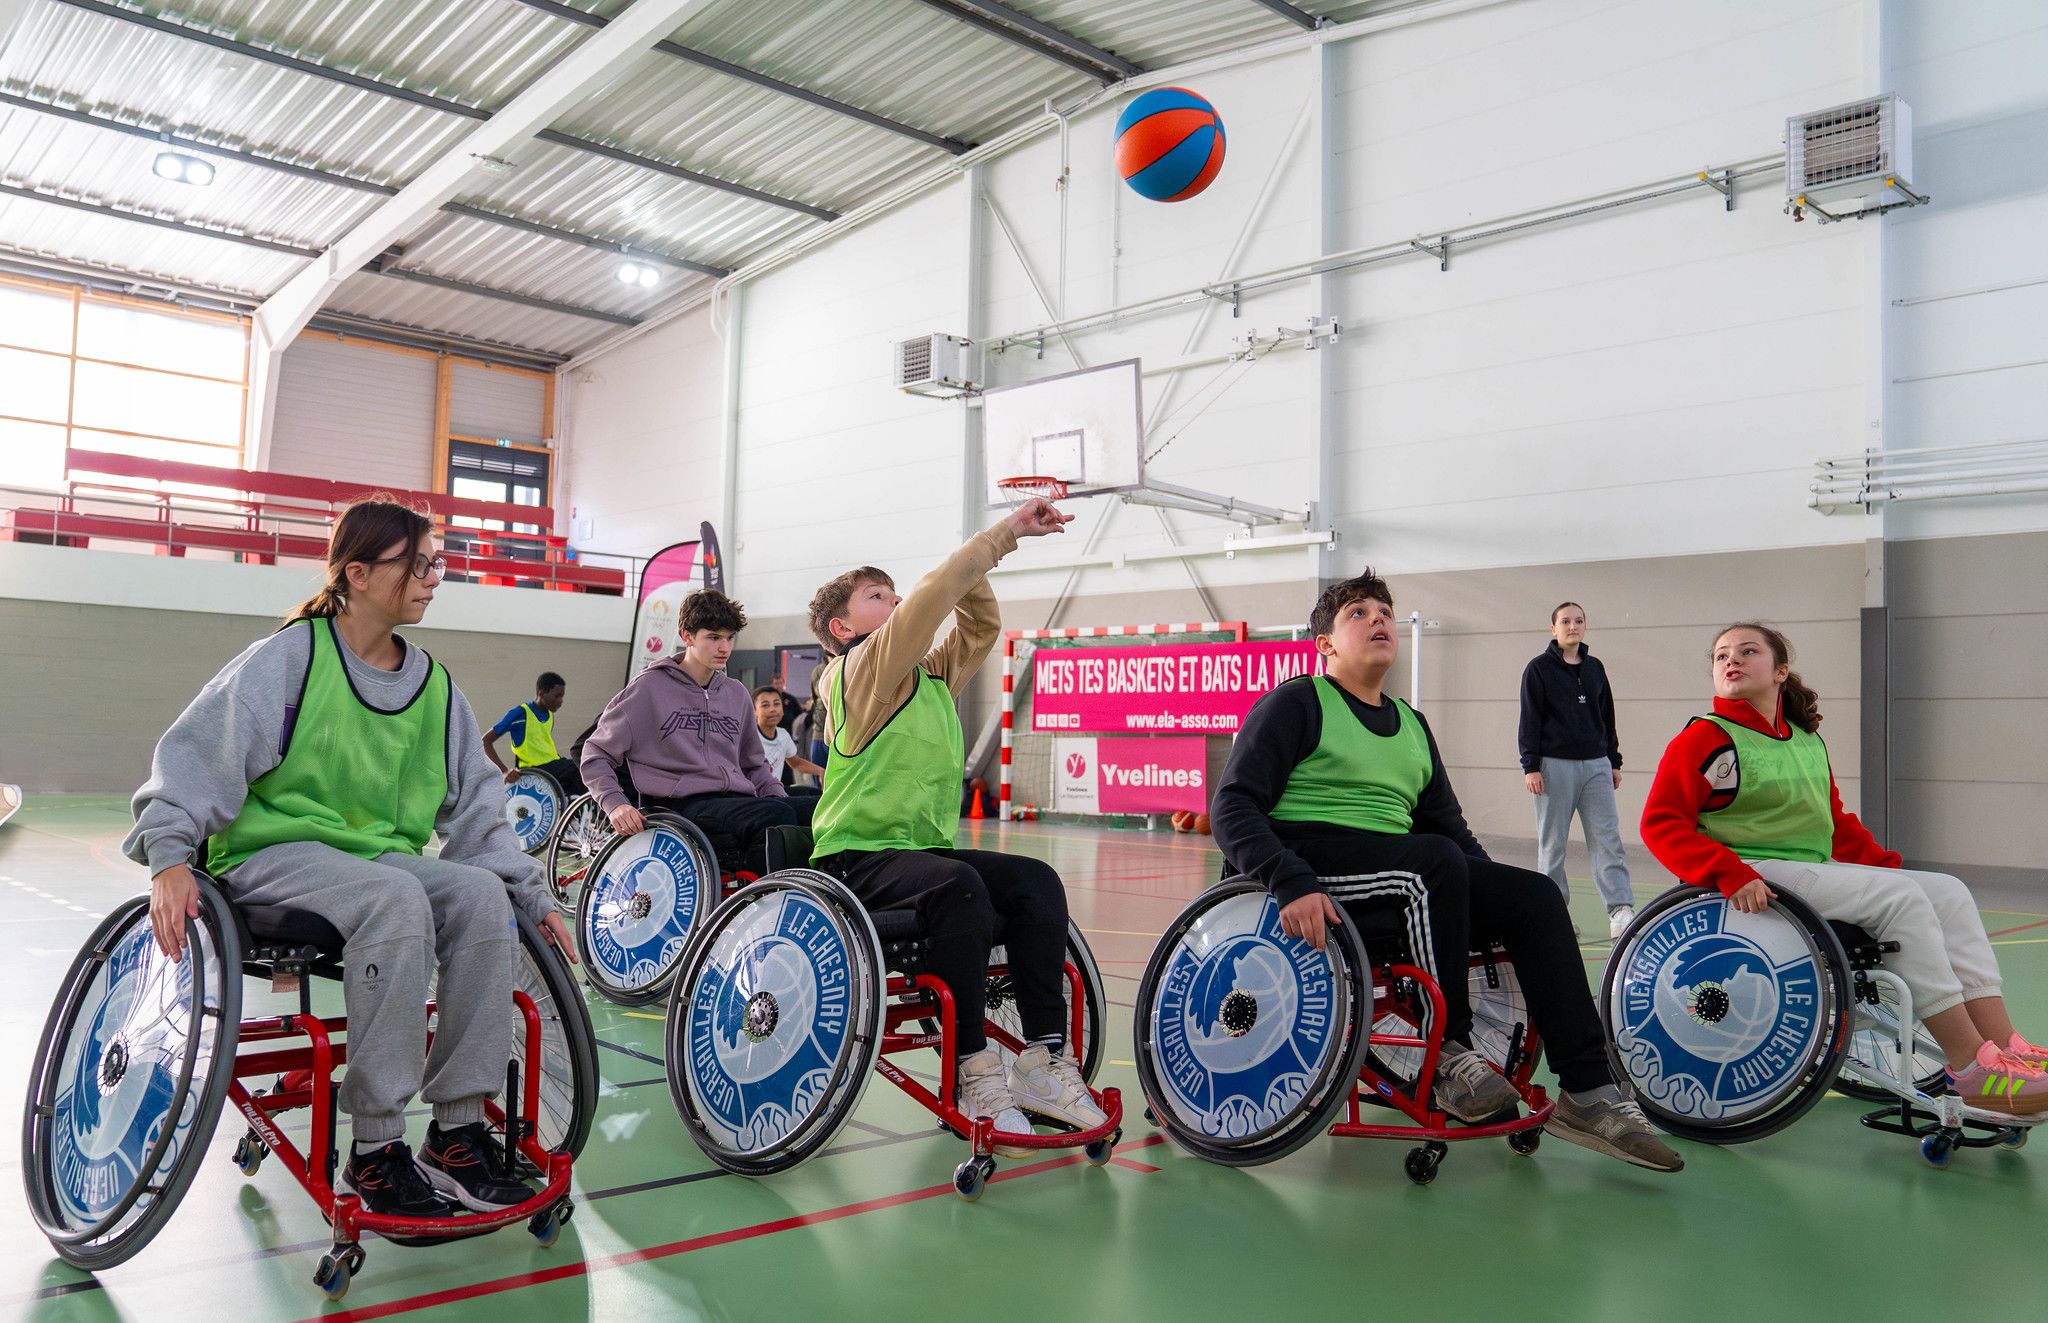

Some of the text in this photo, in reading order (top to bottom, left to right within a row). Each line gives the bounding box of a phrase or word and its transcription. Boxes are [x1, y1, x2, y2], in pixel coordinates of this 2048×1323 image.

[1036, 652, 1328, 694] METS TES BASKETS ET BATS LA MALA
[1126, 711, 1238, 729] www.ela-asso.com
[1101, 763, 1203, 787] Yvelines
[656, 837, 696, 917] LE CHESNAY
[787, 906, 846, 1036] LE CHESNAY
[1629, 909, 1709, 1012] VERSAILLES
[694, 981, 735, 1116] VERSAILLES
[1162, 966, 1205, 1099] VERSAILLES
[1732, 978, 1812, 1093] LE CHESNAY
[889, 1070, 905, 1083] Pro
[265, 1130, 281, 1146] Pro
